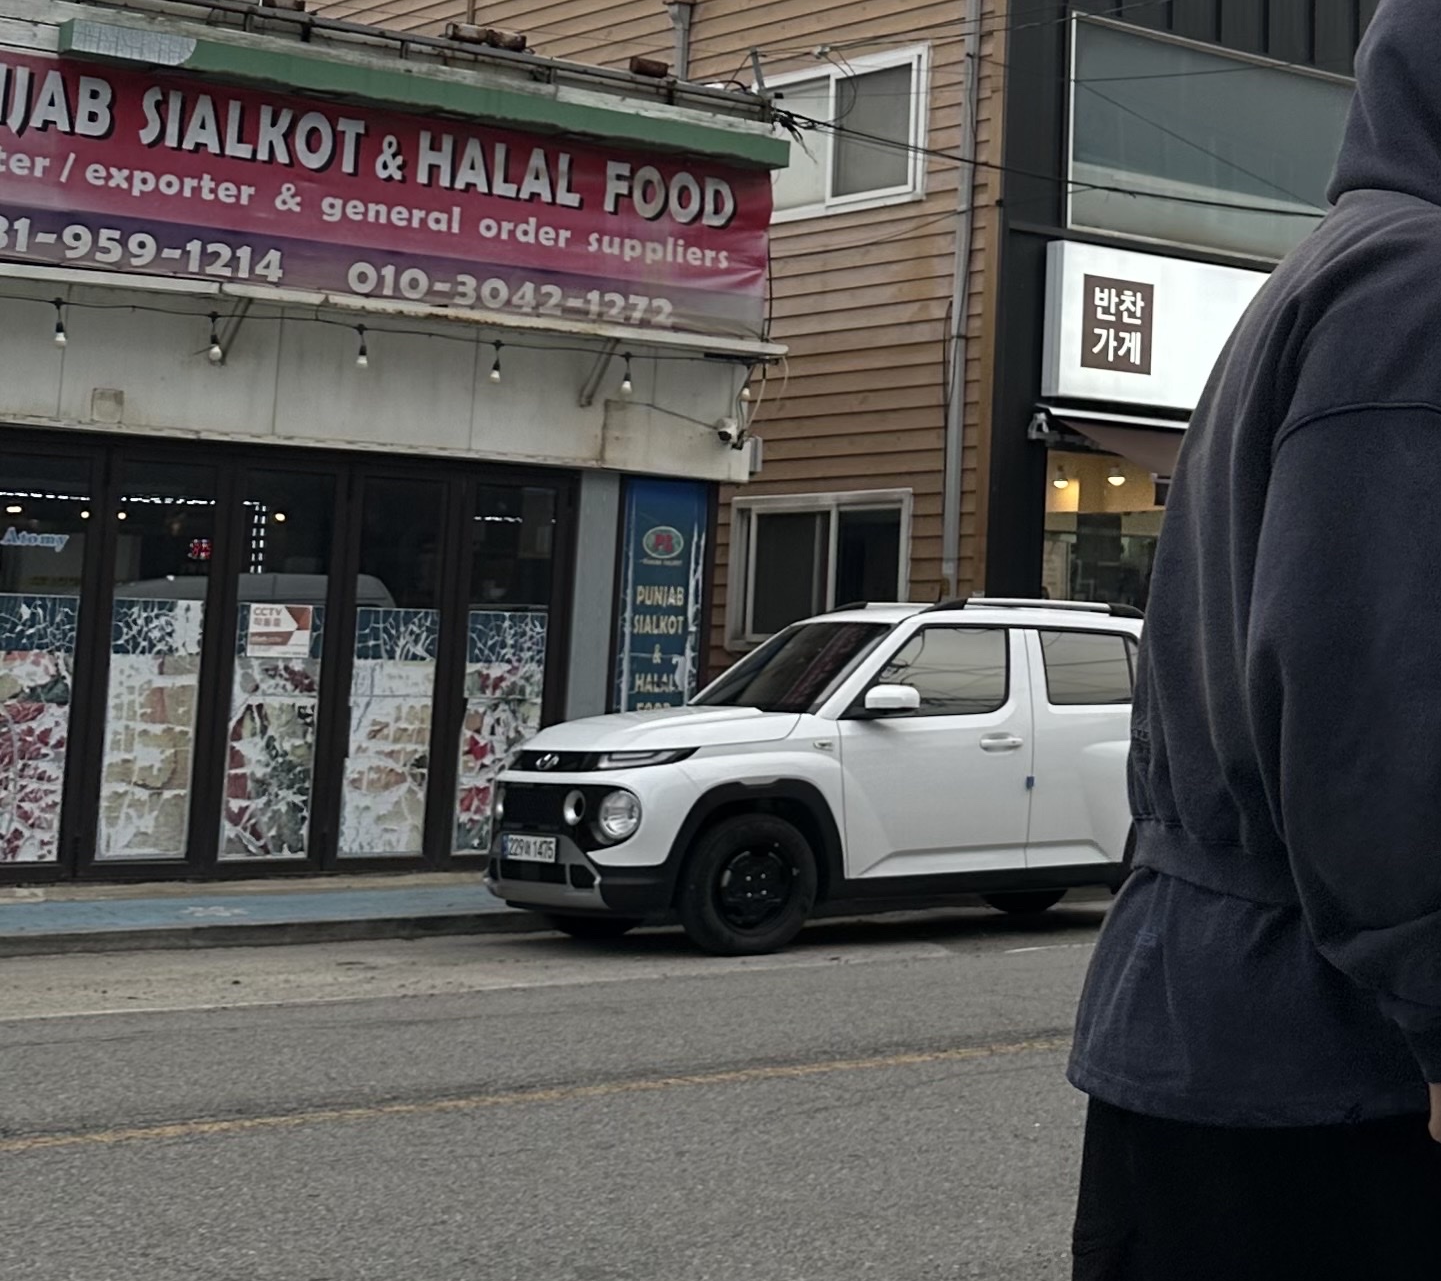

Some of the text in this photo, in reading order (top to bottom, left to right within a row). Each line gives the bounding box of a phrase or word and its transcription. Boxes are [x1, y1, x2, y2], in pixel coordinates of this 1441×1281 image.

[0, 63, 735, 227] JAB SIALKOT & HALAL FOOD
[85, 162, 255, 206] exporter
[275, 183, 302, 213] &
[321, 195, 461, 234] general
[479, 216, 572, 249] order
[587, 232, 730, 270] suppliers
[348, 261, 673, 327] 010-3042-1272
[1094, 286, 1145, 325] 반찬
[1092, 328, 1141, 365] 가게
[0, 526, 70, 552] Atomy
[636, 585, 684, 607] PUNJAB
[253, 607, 282, 617] CCTV
[633, 614, 684, 635] SIALKOT
[652, 643, 662, 664] &
